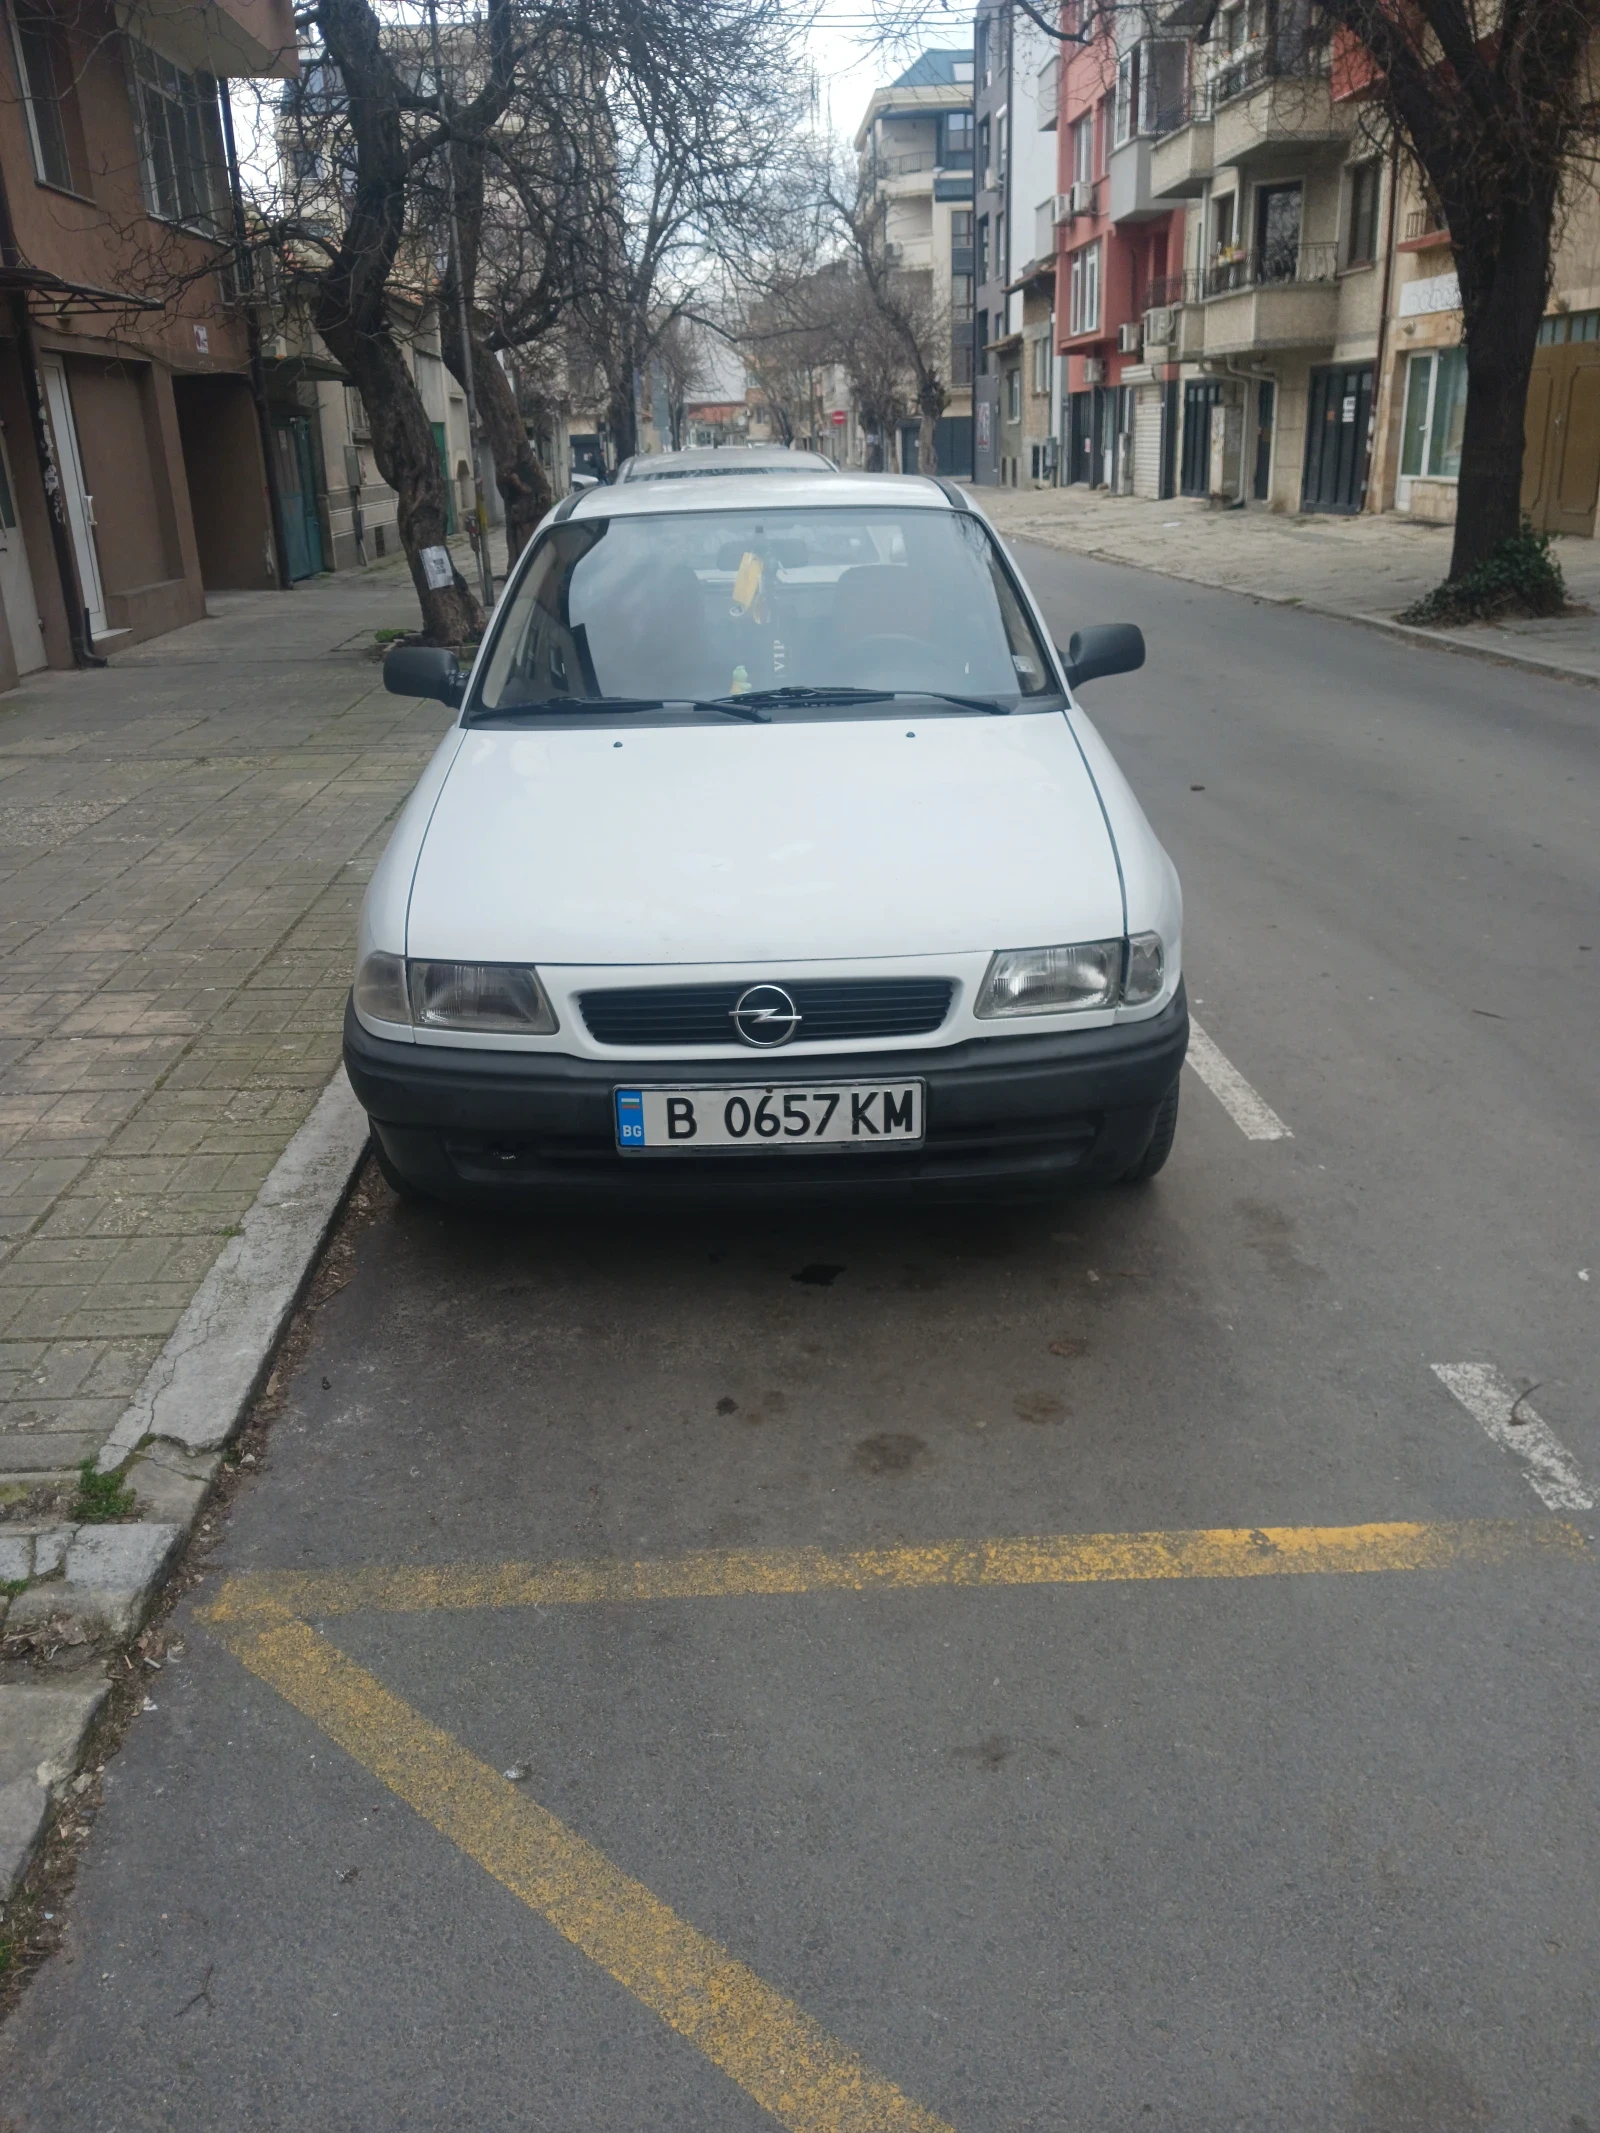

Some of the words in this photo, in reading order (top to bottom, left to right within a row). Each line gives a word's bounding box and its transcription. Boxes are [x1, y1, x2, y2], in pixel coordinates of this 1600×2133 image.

[773, 640, 785, 672] VIP
[622, 1125, 642, 1138] BG
[666, 1097, 697, 1139] B
